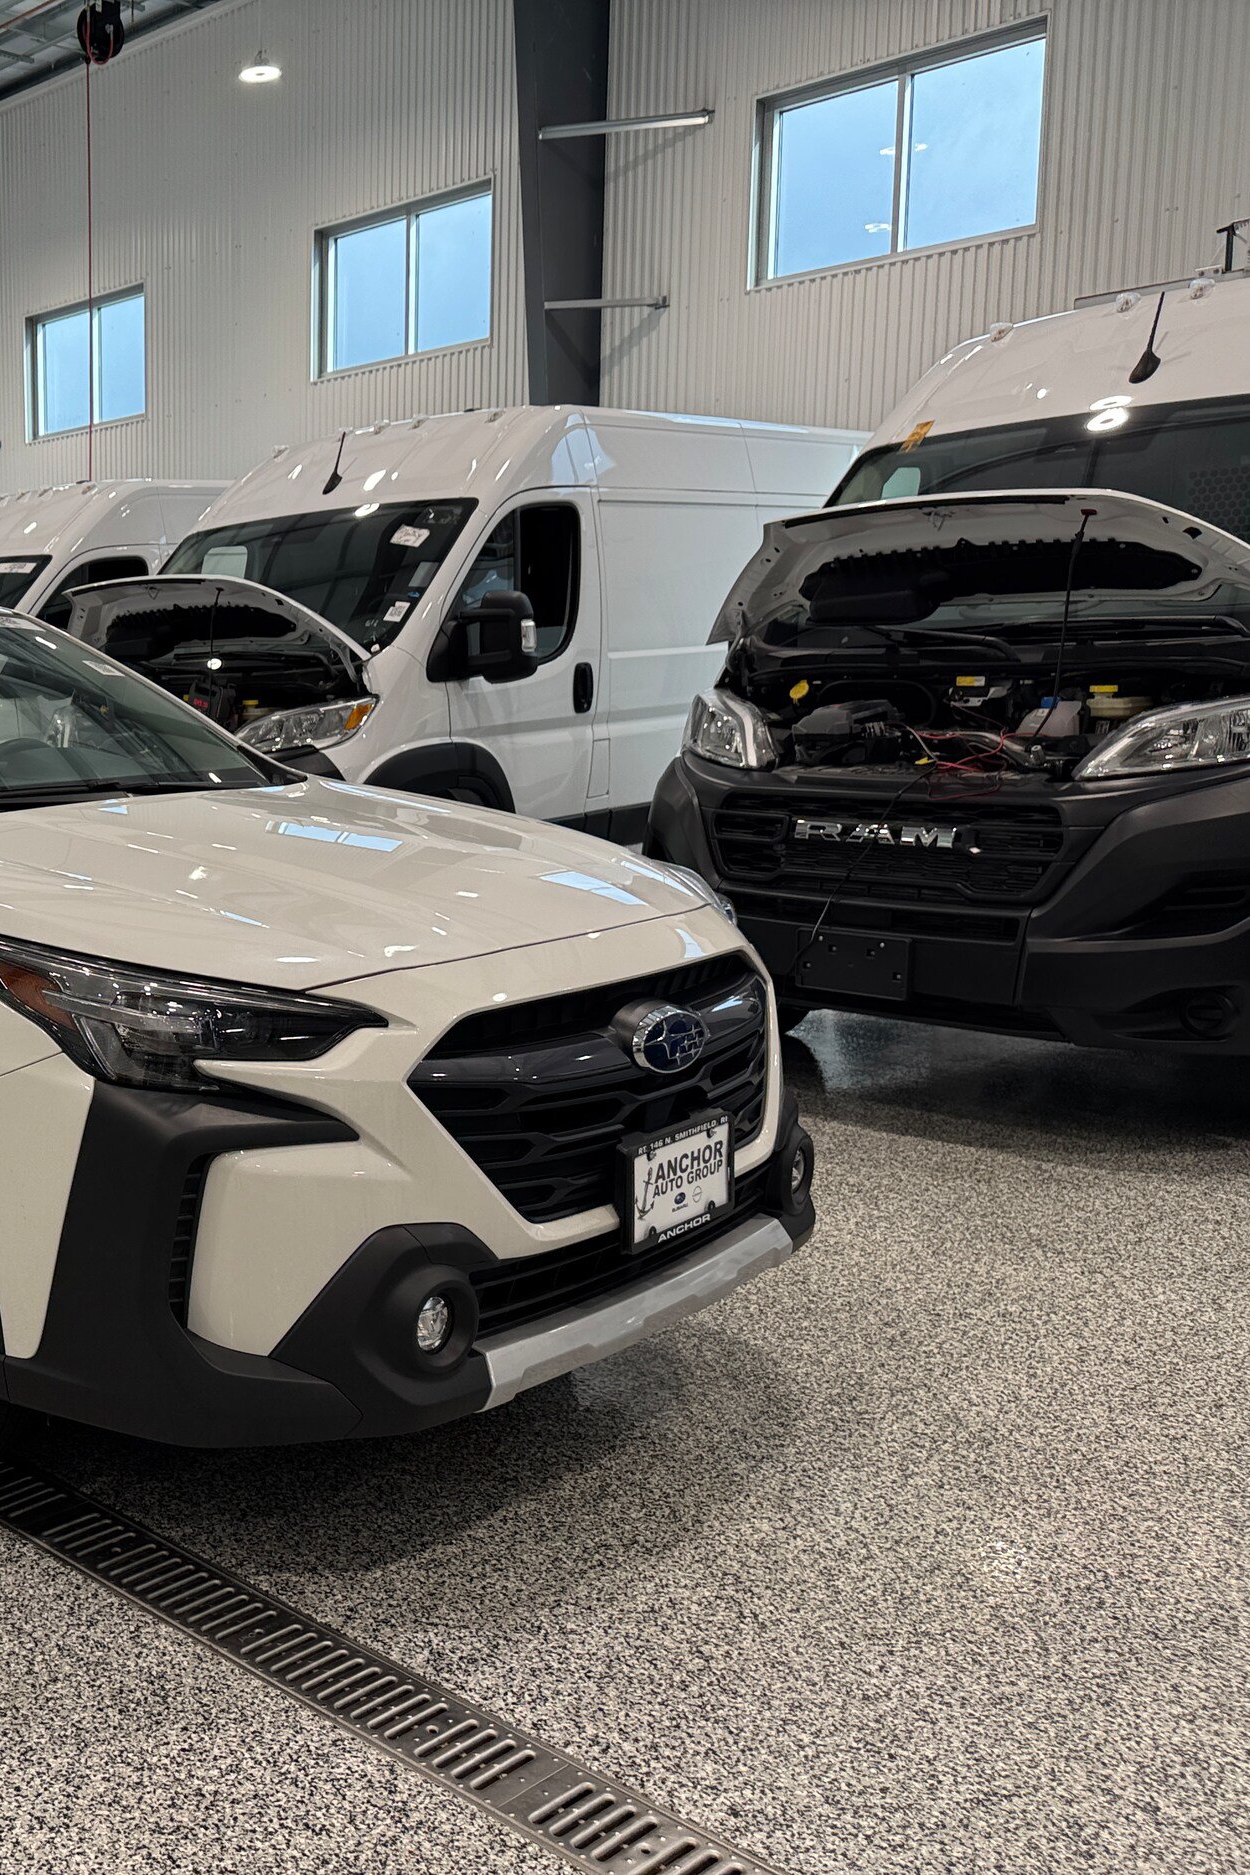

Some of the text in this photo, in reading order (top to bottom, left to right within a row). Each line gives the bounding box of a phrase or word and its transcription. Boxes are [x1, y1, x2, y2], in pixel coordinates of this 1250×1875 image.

[794, 819, 957, 849] RAM
[650, 1140, 664, 1150] 146
[675, 1120, 717, 1141] SMITHFIELD
[720, 1115, 728, 1123] RI
[652, 1159, 723, 1199] AUTO GROUP
[654, 1140, 724, 1184] ANCHOR
[657, 1213, 711, 1243] ANCHOR
